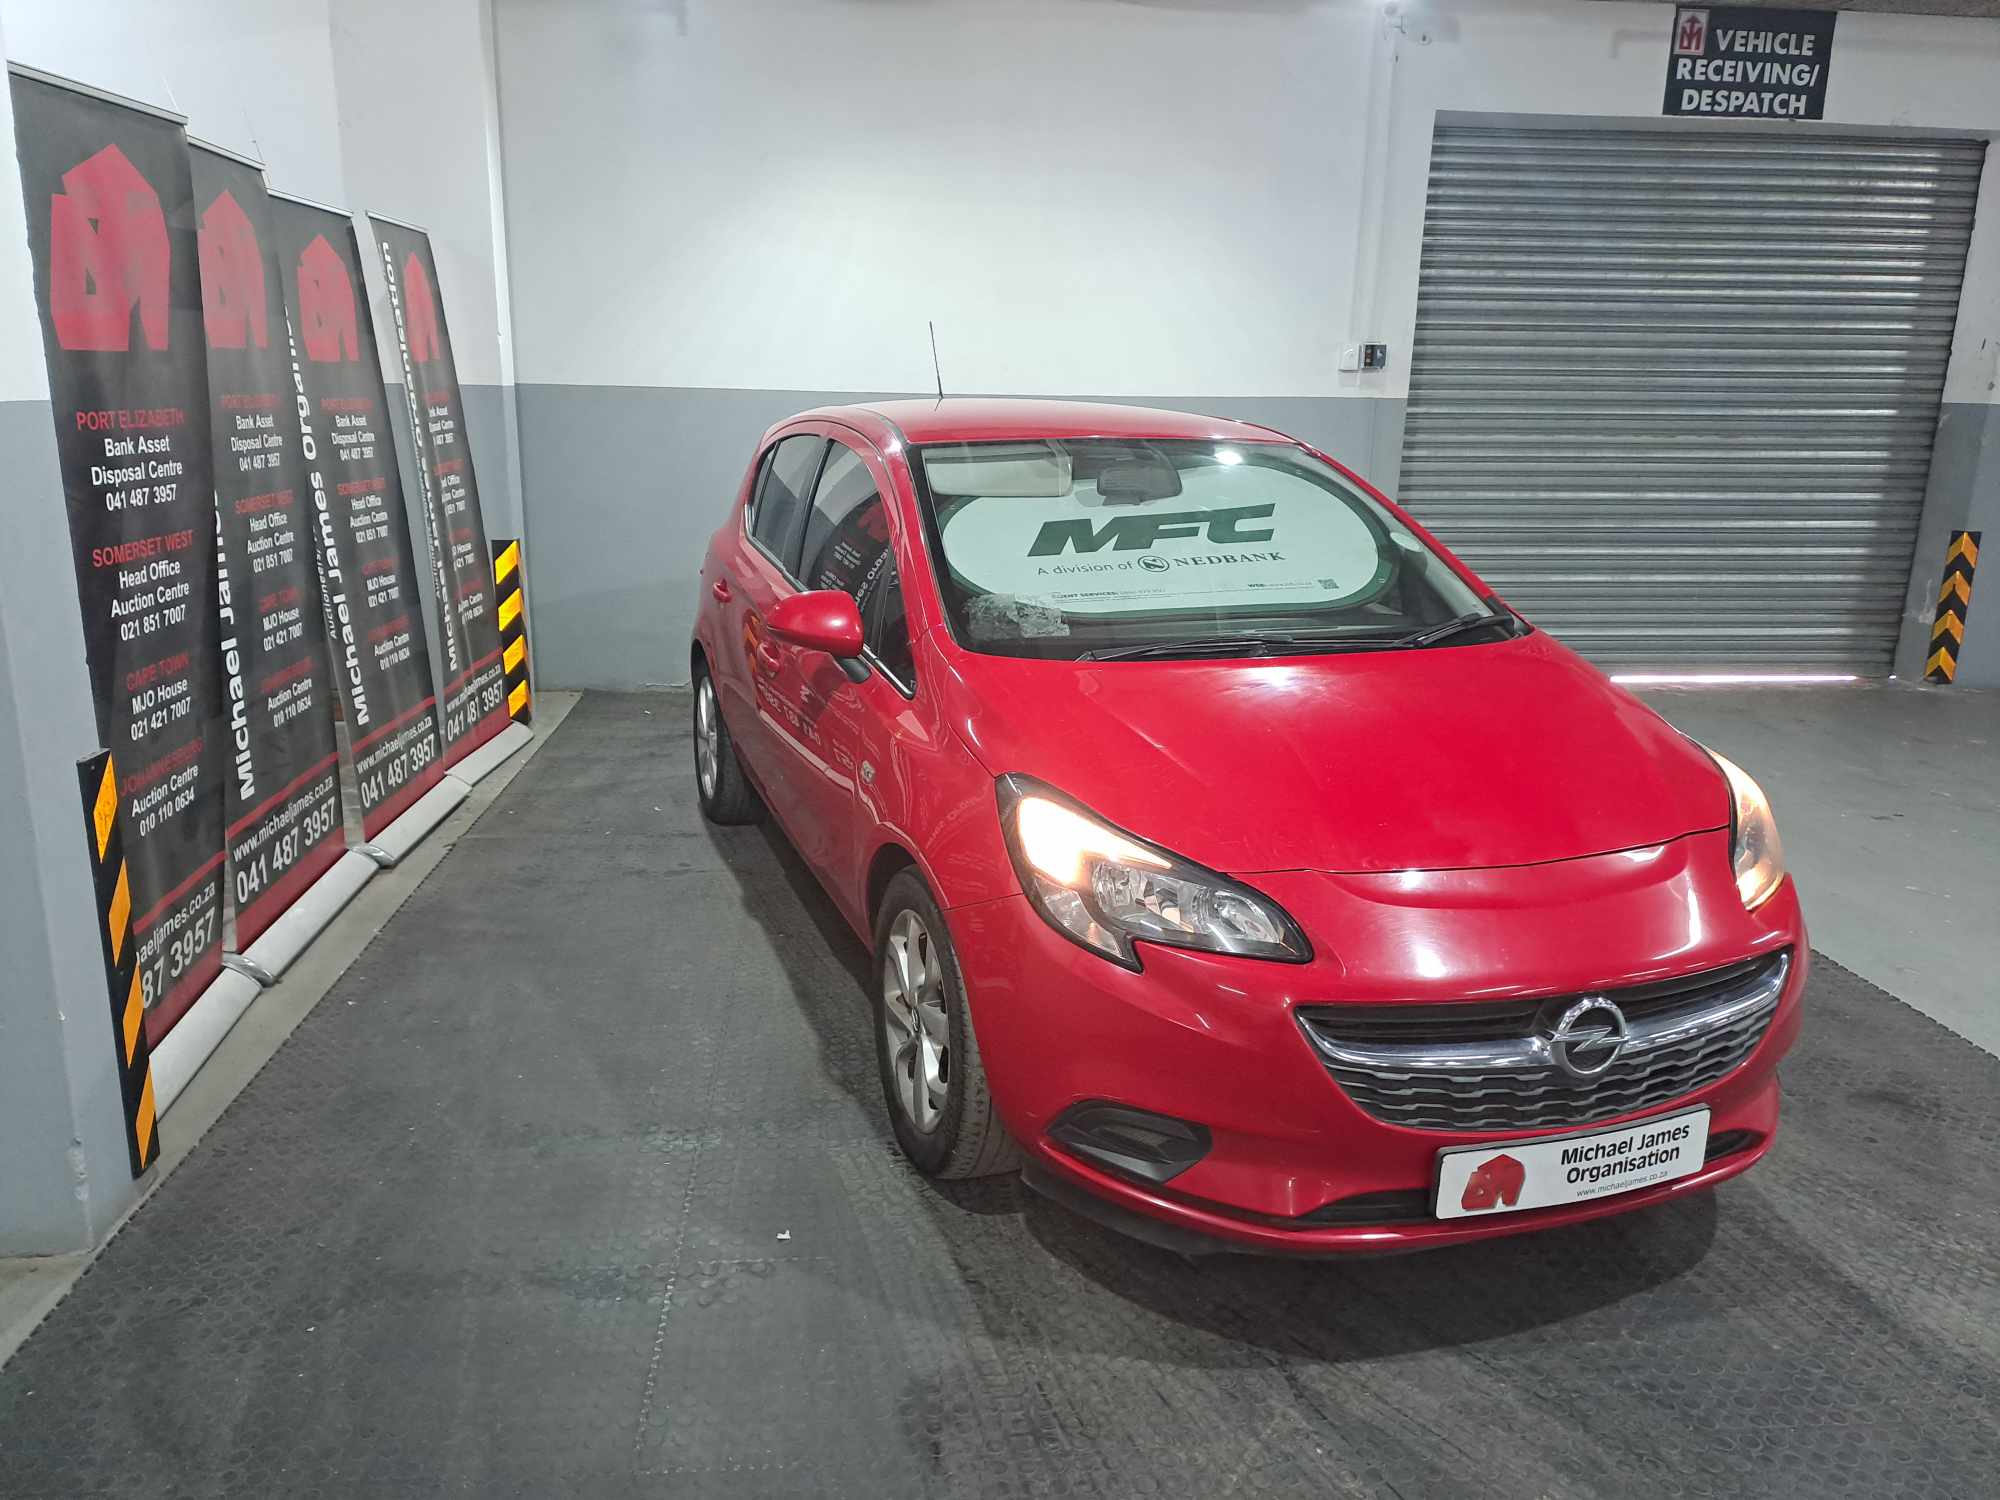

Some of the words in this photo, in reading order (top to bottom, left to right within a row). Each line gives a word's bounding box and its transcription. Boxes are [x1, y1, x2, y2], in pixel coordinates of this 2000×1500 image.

[1715, 29, 1816, 56] VEHICLE
[1676, 58, 1820, 88] RECEIVING/
[1681, 88, 1807, 115] DESPATCH
[76, 410, 115, 431] PORT
[236, 414, 255, 430] Bank
[104, 437, 134, 457] Bank
[138, 435, 170, 454] Asset
[231, 434, 262, 454] Disposal
[91, 461, 145, 487] Disposal
[149, 460, 182, 479] Centre
[105, 492, 126, 511] 041
[129, 488, 149, 507] 487
[153, 484, 177, 503] 3957
[247, 535, 273, 555] Auction
[311, 471, 343, 584] James
[1027, 503, 1275, 557] MFC
[92, 536, 161, 568] SOMERSET
[164, 530, 193, 552] WEST
[1038, 567, 1049, 575] A
[1053, 564, 1114, 575] division
[1118, 560, 1133, 570] of
[1173, 552, 1287, 566] NEDBANK
[119, 562, 147, 589] Head
[149, 560, 180, 581] Office
[111, 592, 155, 618] Auction
[157, 581, 190, 606] Centre
[121, 619, 140, 641] 021
[143, 613, 161, 635] 851
[162, 604, 186, 627] 7007
[333, 593, 370, 726] Michael
[131, 690, 155, 715] MJO
[157, 678, 188, 703] House
[267, 688, 292, 712] Auction
[448, 710, 464, 742] 041
[482, 679, 503, 712] 3957
[130, 718, 148, 741] 021
[150, 708, 168, 730] 421
[170, 697, 192, 721] 7007
[220, 637, 256, 801] Michael
[361, 770, 385, 808] 041
[388, 753, 408, 787] 487
[410, 733, 434, 771] 3957
[131, 784, 168, 817] Auction
[170, 765, 199, 791] Centre
[139, 814, 156, 837] 010
[158, 801, 173, 823] 110
[236, 853, 268, 904] 041
[272, 826, 299, 871] 487
[303, 796, 336, 847] 3957
[136, 881, 215, 962] aeljames.co.za
[142, 956, 164, 1009] 87
[170, 906, 216, 978] 3957
[1561, 1136, 1634, 1165] Michael
[1637, 1124, 1690, 1151] James
[1566, 1146, 1680, 1184] Organisation
